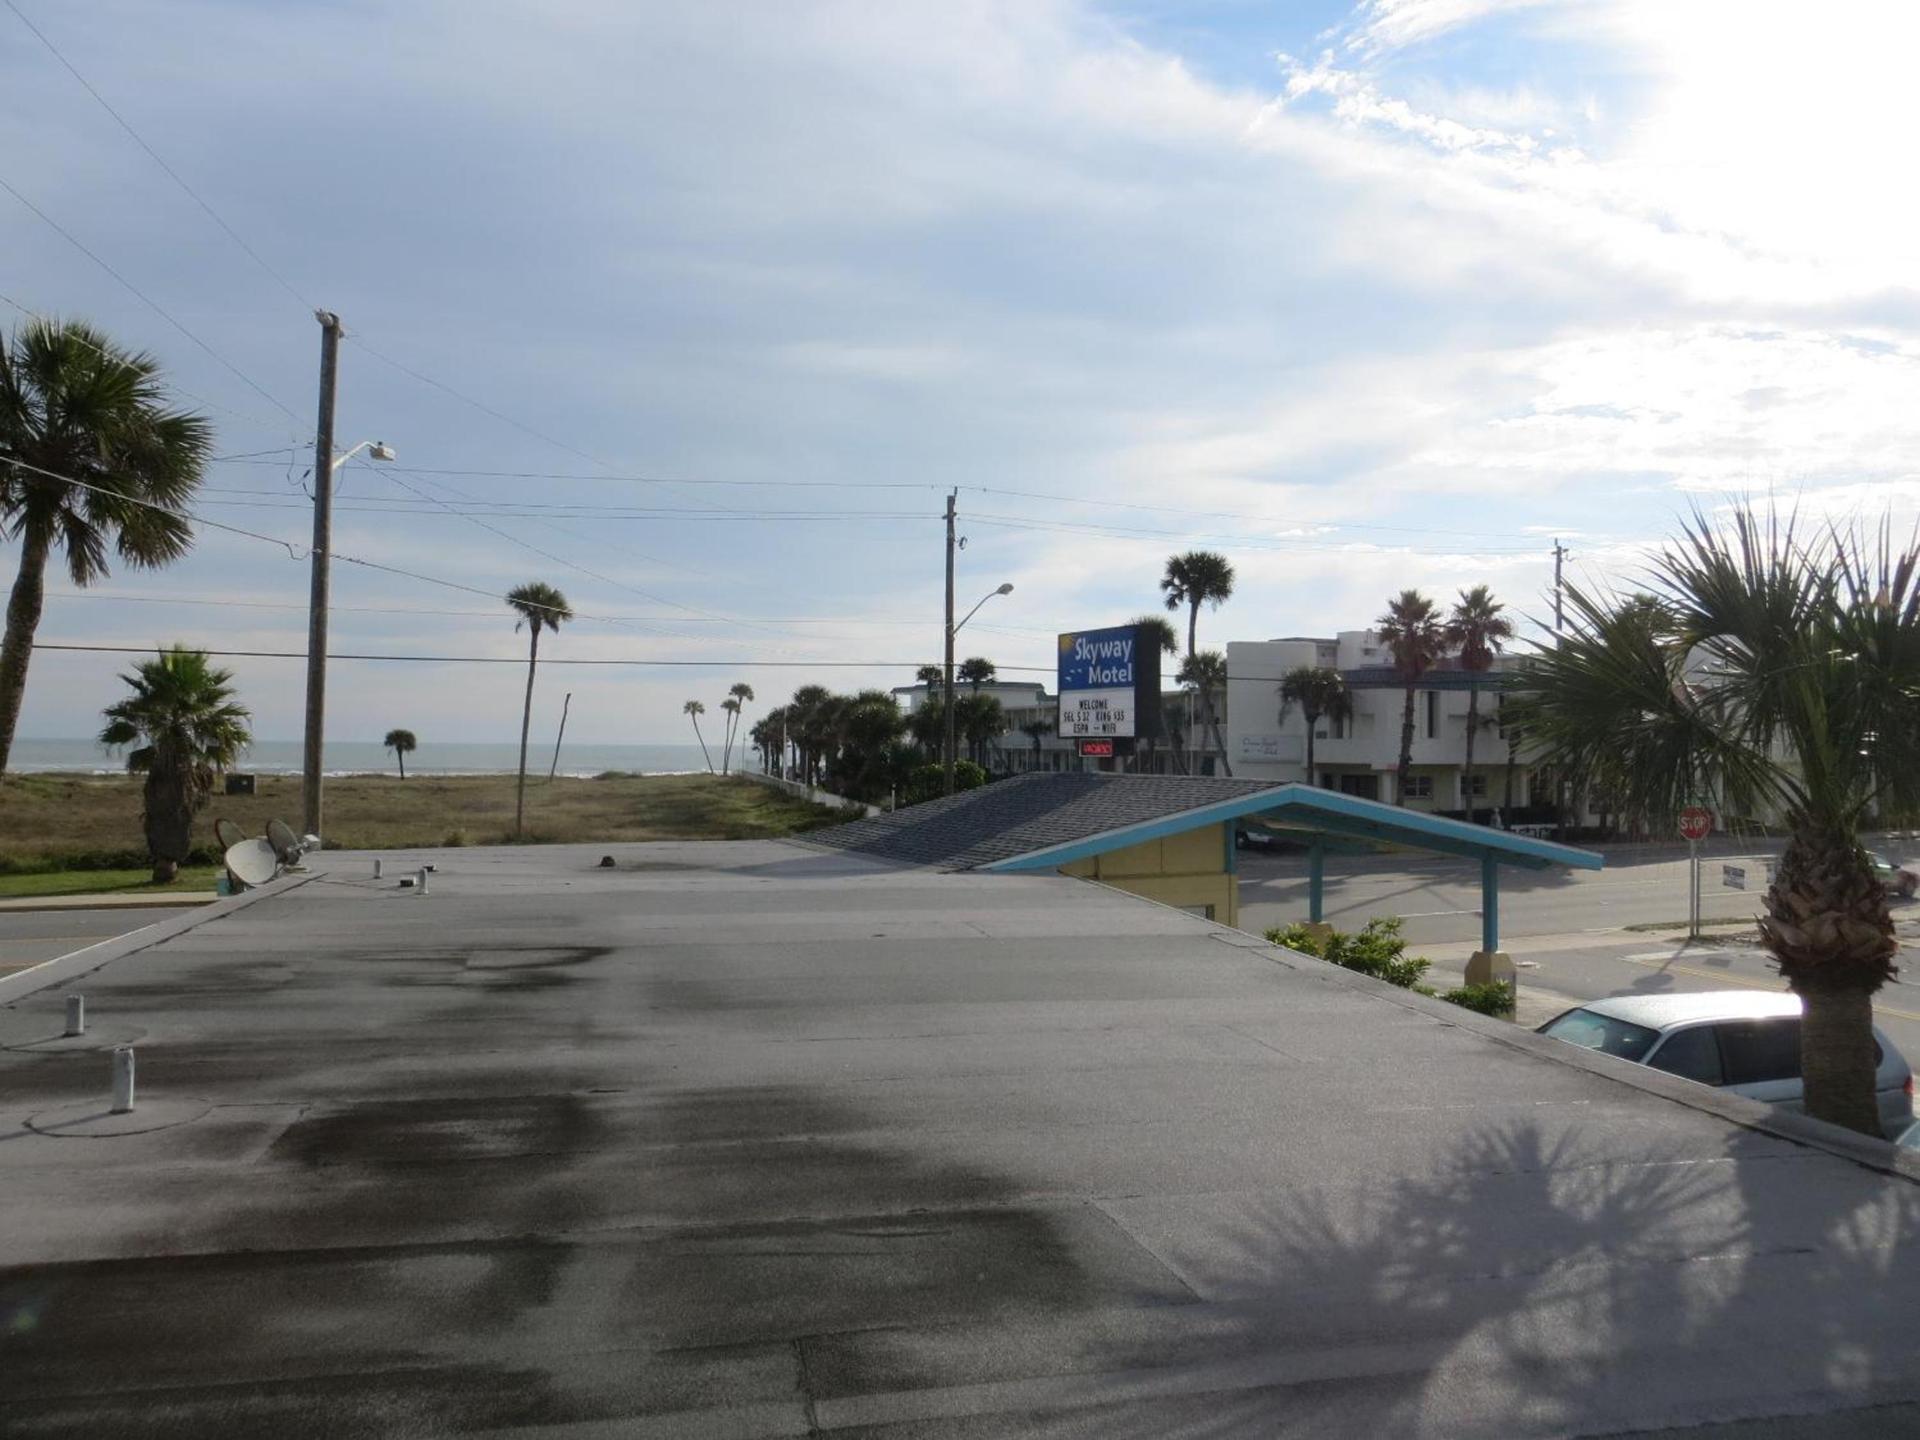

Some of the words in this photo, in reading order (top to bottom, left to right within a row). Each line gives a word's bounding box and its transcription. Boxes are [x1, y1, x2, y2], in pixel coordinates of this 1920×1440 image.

[1075, 637, 1132, 665] Skyway
[1088, 662, 1132, 684] Motel
[1079, 699, 1108, 710] WELCOME
[1095, 711, 1111, 721] KING
[1680, 816, 1706, 830] STOP
